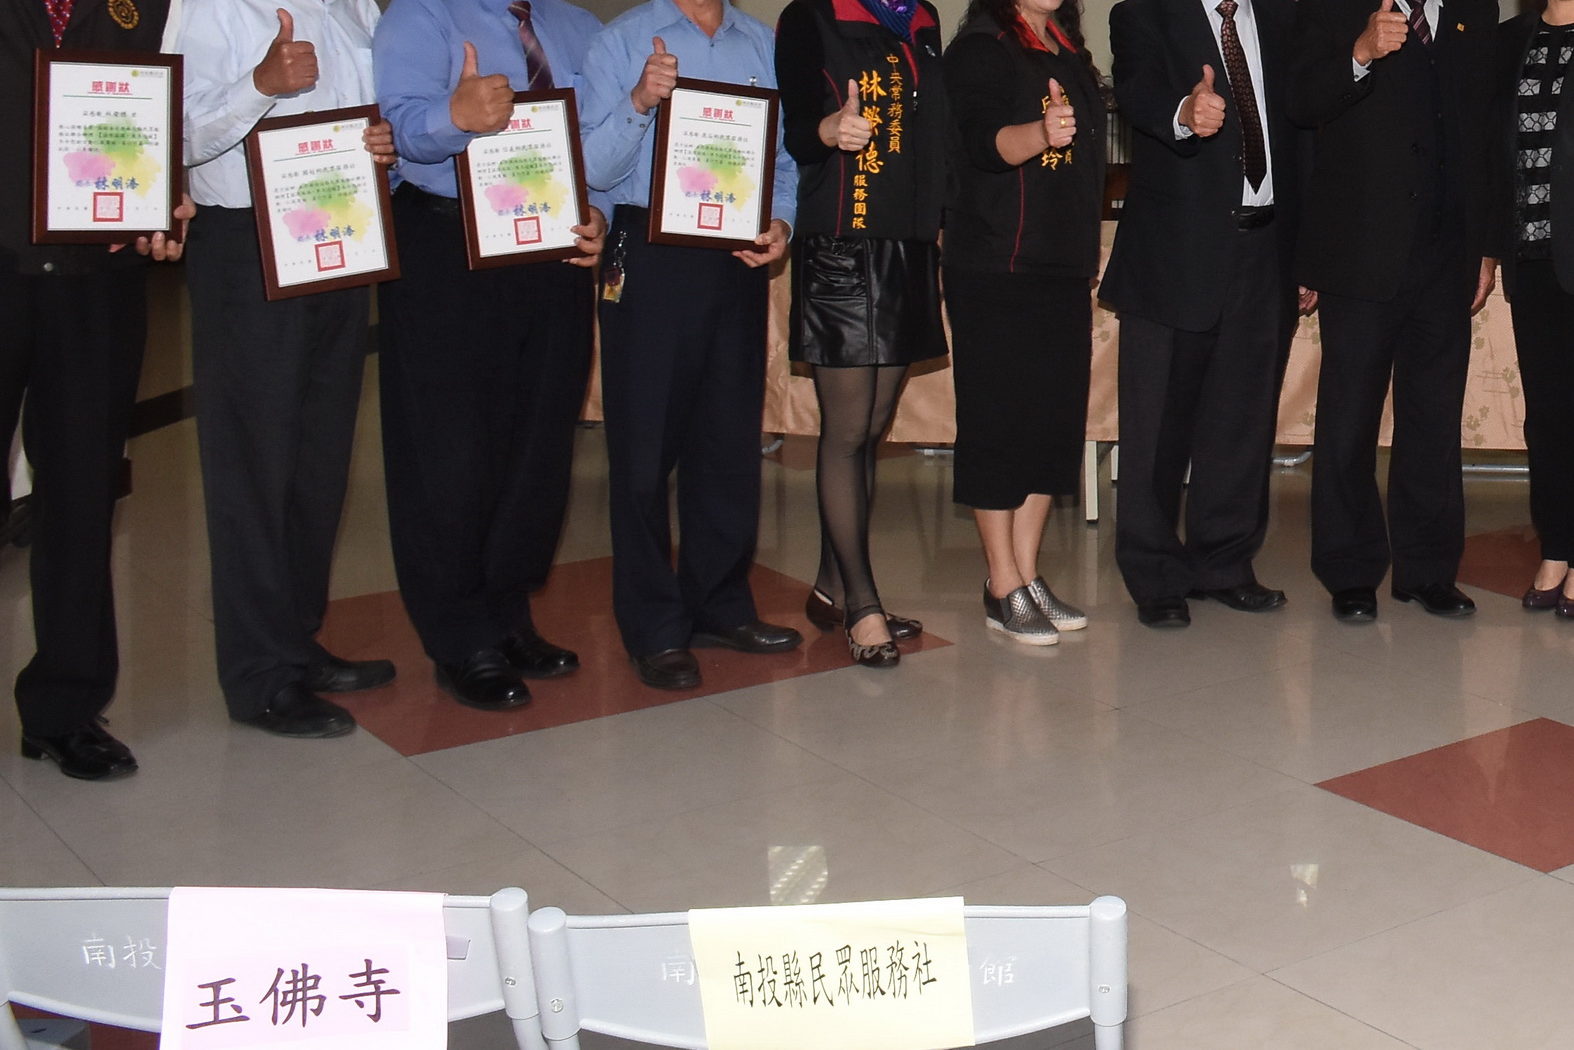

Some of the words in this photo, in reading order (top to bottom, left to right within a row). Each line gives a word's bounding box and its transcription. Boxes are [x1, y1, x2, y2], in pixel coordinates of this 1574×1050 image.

[91, 80, 131, 93] 感謝狀
[886, 53, 904, 153] 中央常務委員
[83, 935, 162, 971] 南投
[732, 940, 938, 1009] 南投縣民眾服務社
[185, 958, 402, 1031] 玉佛寺
